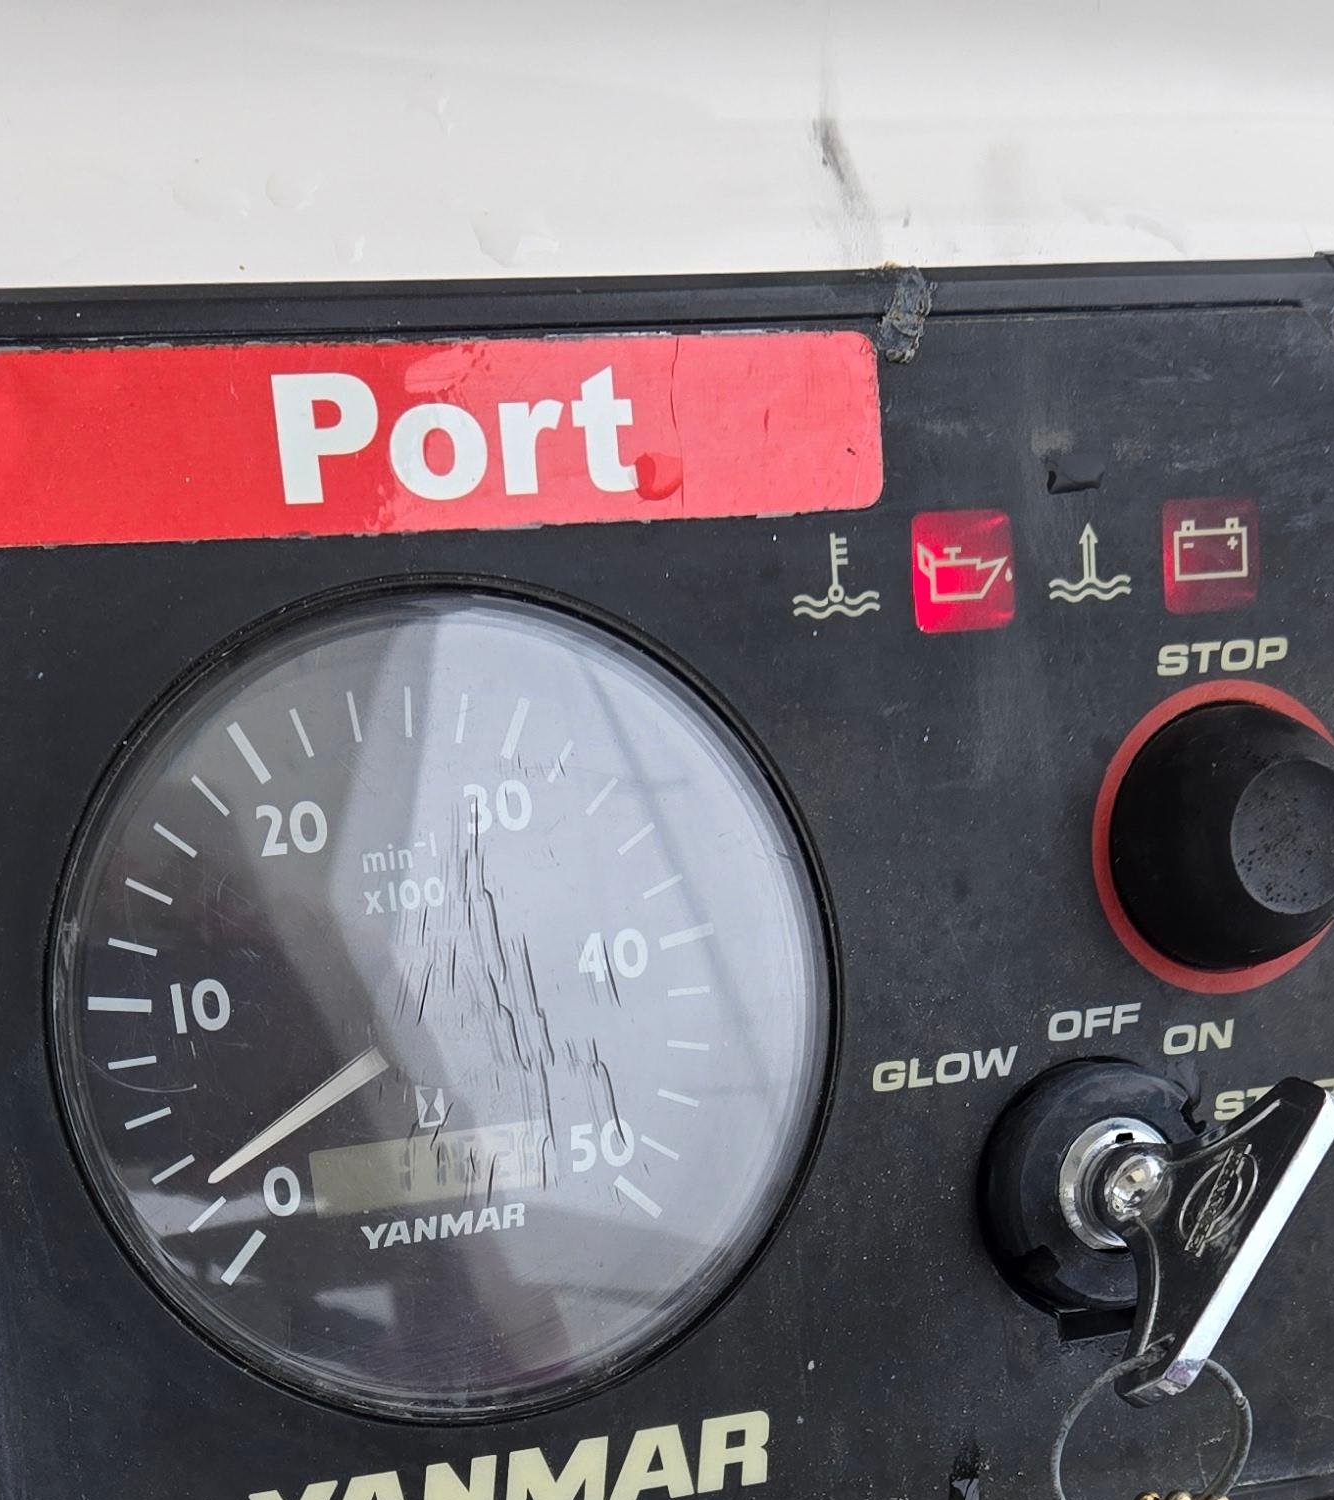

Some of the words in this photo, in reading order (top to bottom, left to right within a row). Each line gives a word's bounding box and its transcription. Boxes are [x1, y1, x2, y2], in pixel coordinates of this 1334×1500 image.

[271, 365, 639, 504] Port
[1157, 637, 1288, 676] STOP
[255, 801, 328, 856] 20
[463, 781, 533, 835] 30
[579, 931, 648, 982] 40
[170, 980, 231, 1033] 10
[1048, 1003, 1141, 1042] OFF
[1163, 1020, 1234, 1056] ON
[872, 1046, 1018, 1092] GLOW
[570, 1119, 635, 1172] 50
[264, 1166, 301, 1216] 0
[361, 1203, 525, 1250] YANMAR
